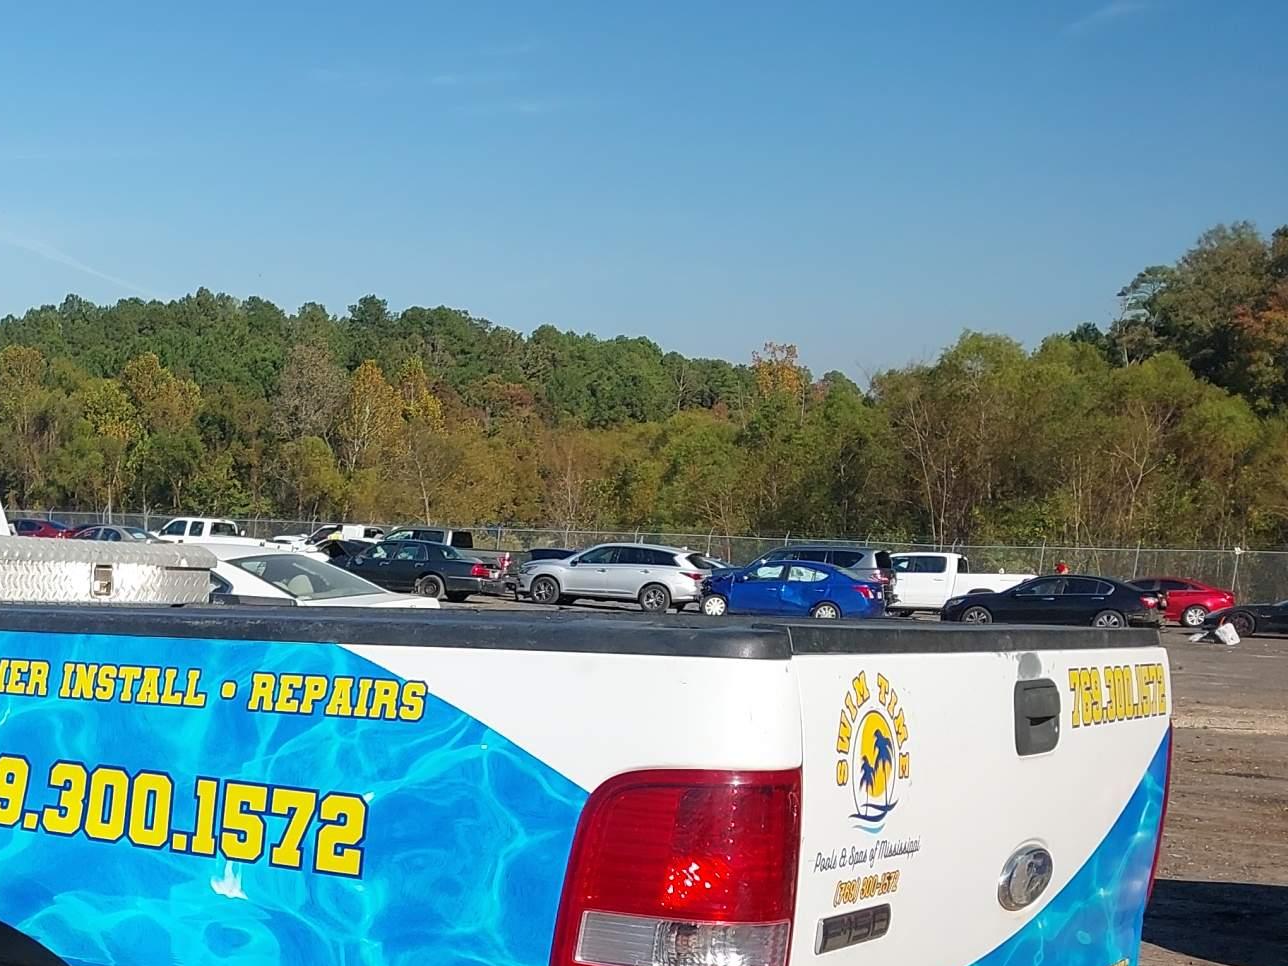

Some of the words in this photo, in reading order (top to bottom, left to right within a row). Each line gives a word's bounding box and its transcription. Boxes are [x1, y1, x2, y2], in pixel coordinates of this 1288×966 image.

[59, 659, 208, 708] INSTALL
[248, 673, 429, 722] REPAIRS
[1068, 663, 1167, 728] 769.300.1572
[836, 670, 869, 786] SWIM
[877, 672, 910, 780] TIME
[814, 849, 837, 872] Pools
[849, 845, 868, 871] Spas
